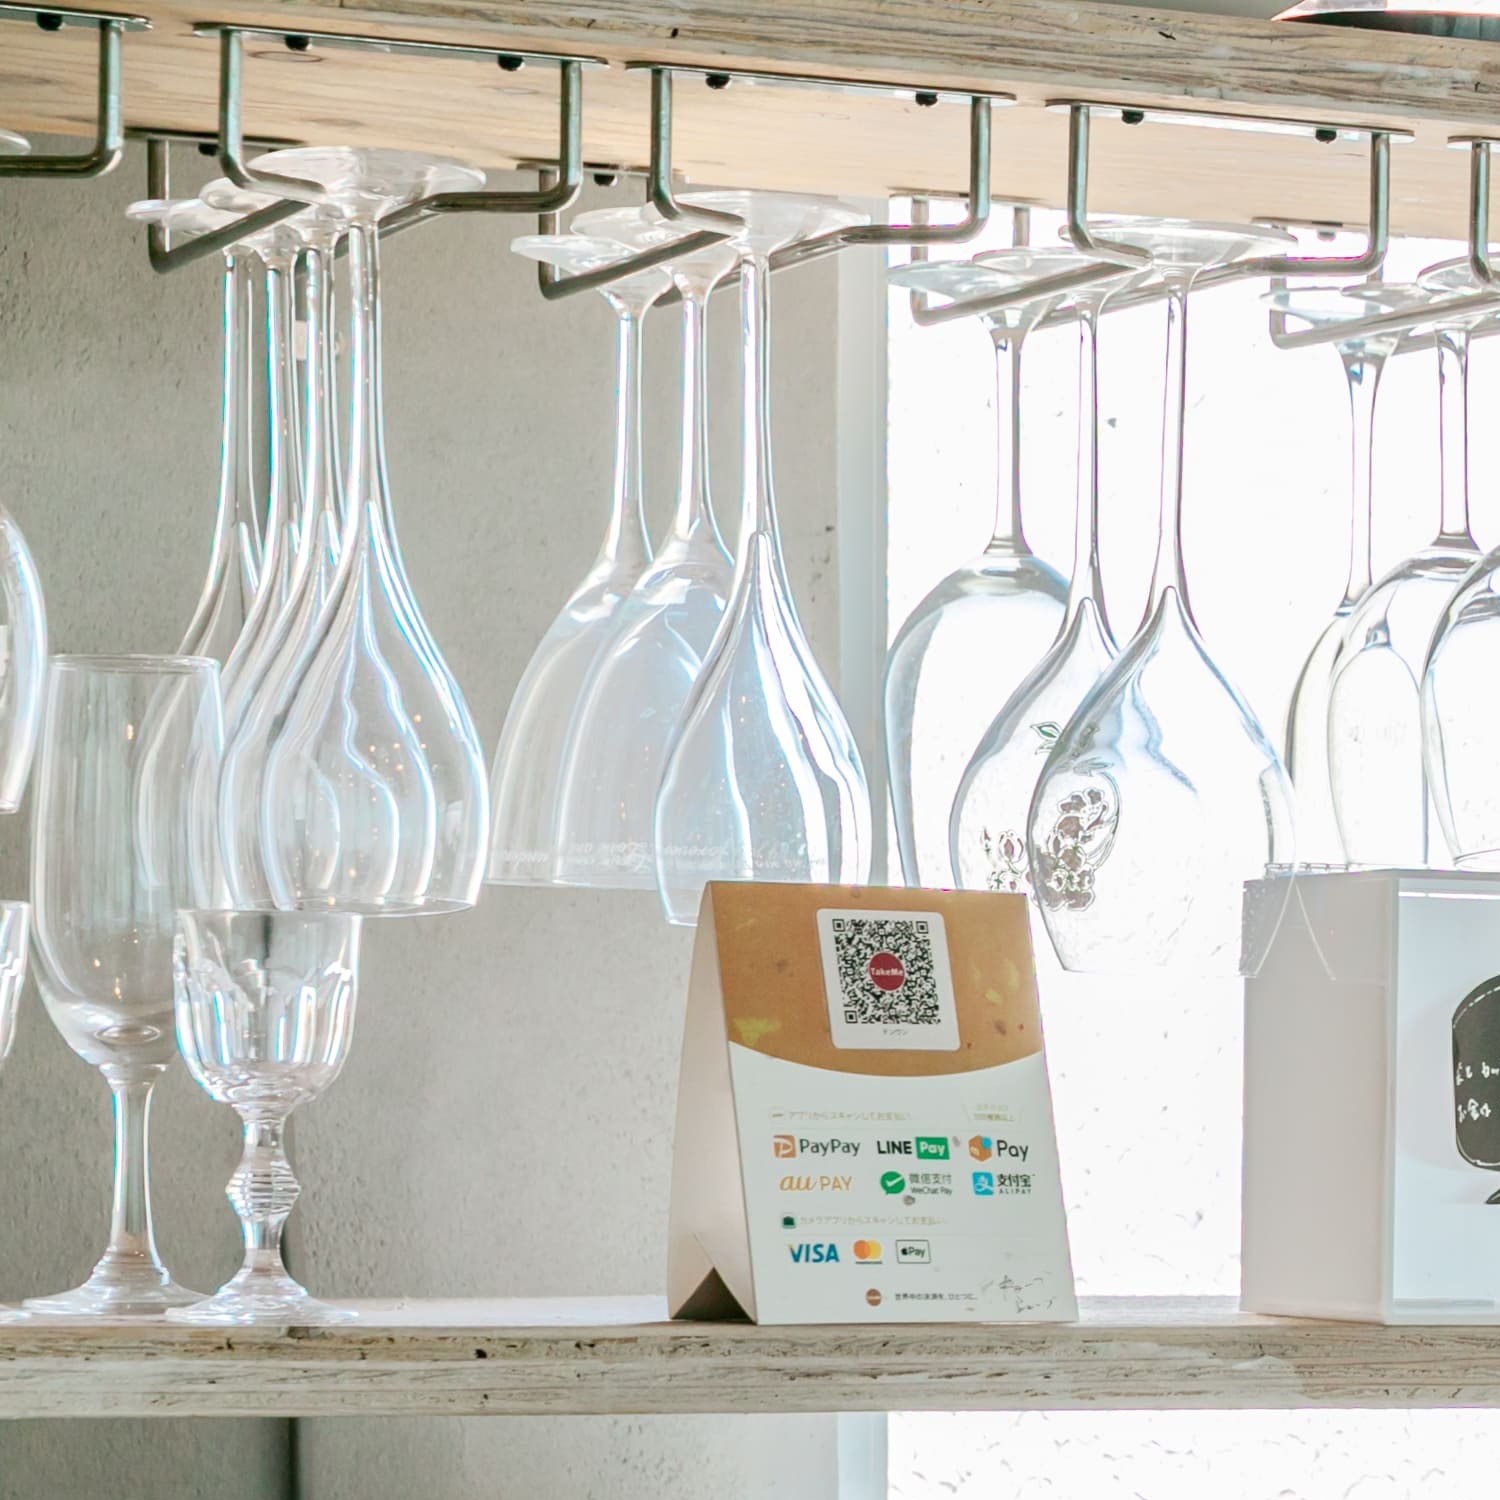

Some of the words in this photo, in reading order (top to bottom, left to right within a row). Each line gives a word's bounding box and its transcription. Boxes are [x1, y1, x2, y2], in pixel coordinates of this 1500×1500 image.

[870, 967, 904, 977] TakeMe
[799, 1138, 861, 1157] PayPay
[877, 1140, 913, 1155] LINE
[919, 1141, 945, 1158] Pay
[996, 1140, 1029, 1162] Pay
[779, 1175, 818, 1192] au
[819, 1176, 853, 1192] PAY
[996, 1174, 1032, 1188] 支付宝
[910, 1186, 941, 1195] WeChat
[998, 1187, 1032, 1195] ALIPAY
[788, 1243, 840, 1264] VISA
[907, 1246, 926, 1258] Pay
